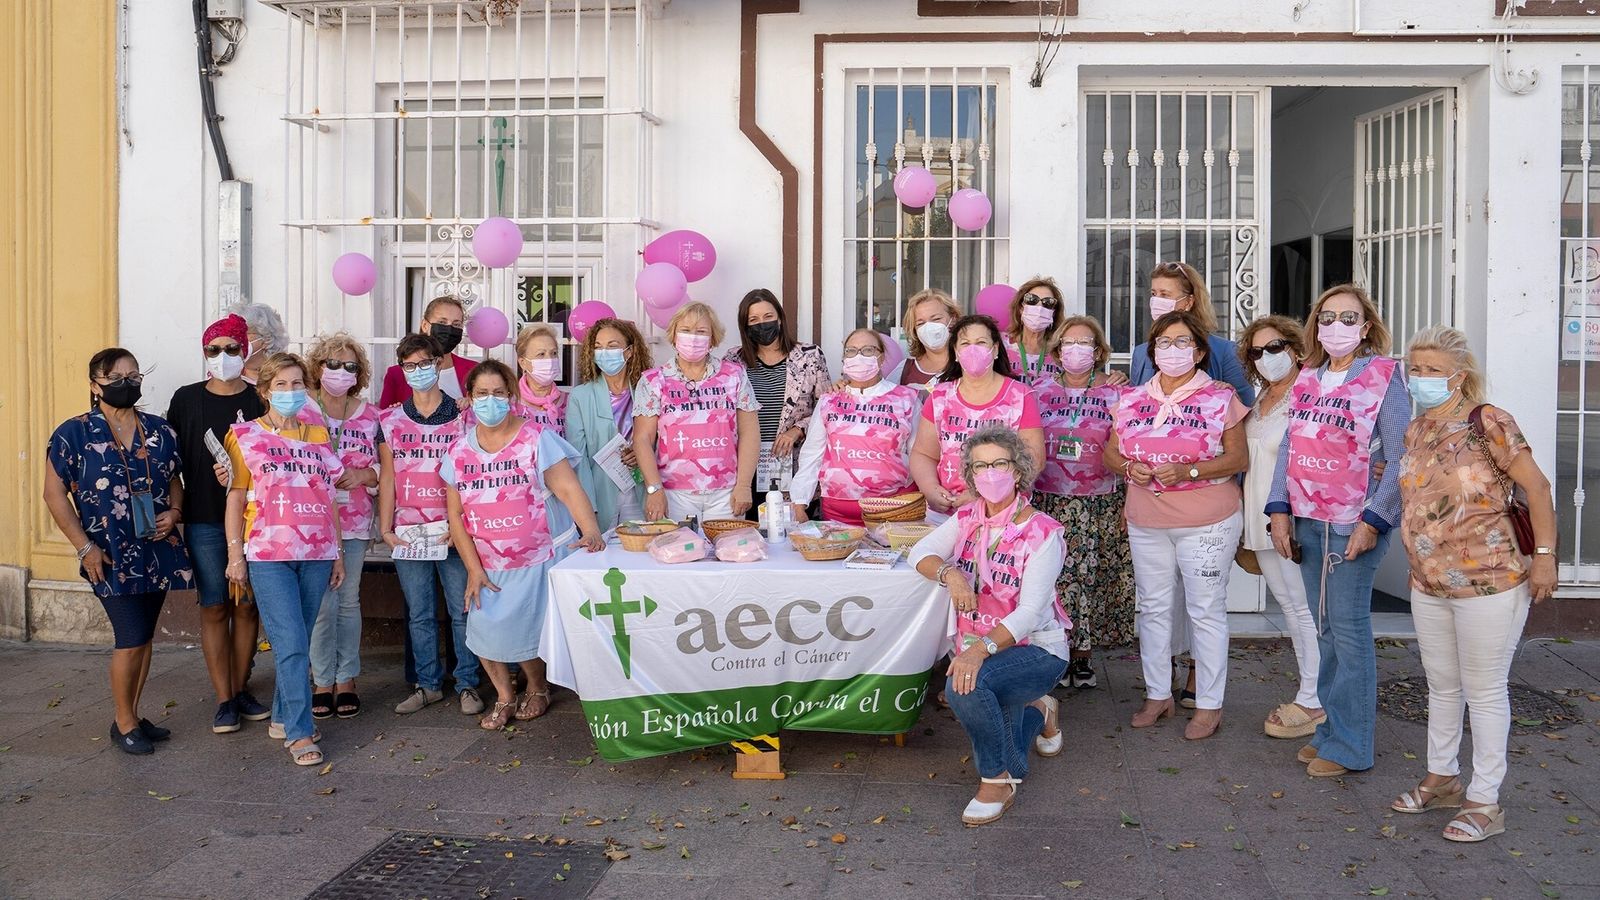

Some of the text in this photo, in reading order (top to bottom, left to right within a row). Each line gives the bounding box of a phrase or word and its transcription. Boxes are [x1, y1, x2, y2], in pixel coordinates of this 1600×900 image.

[669, 386, 727, 398] TU LUCHA
[664, 404, 676, 414] ES
[681, 403, 694, 412] MI
[837, 401, 894, 414] TU LUCHA
[1057, 409, 1070, 417] MI
[1140, 405, 1155, 413] TU
[827, 413, 900, 429] ES MI LUCHA
[948, 416, 963, 426] TU
[1127, 418, 1141, 428] ES
[1297, 409, 1311, 421] MI
[1312, 411, 1356, 431] LUCHA
[401, 434, 416, 443] TU
[692, 436, 728, 448] aecc
[268, 447, 285, 456] TU
[393, 449, 406, 459] ES
[410, 448, 424, 458] MI
[847, 448, 886, 461] aecc
[1147, 452, 1190, 464] aecc
[1297, 454, 1340, 471] aecc
[262, 461, 278, 474] ES
[283, 461, 297, 472] MI
[464, 459, 520, 474] TU LUCHA
[457, 474, 530, 491] ES MI LUCHA
[417, 487, 447, 497] aec
[293, 502, 327, 514] aecc
[483, 515, 524, 529] aecc
[674, 595, 876, 655] aecc
[711, 649, 851, 672] Contra el Cáncer
[641, 700, 759, 738] Española
[859, 688, 881, 713] el
